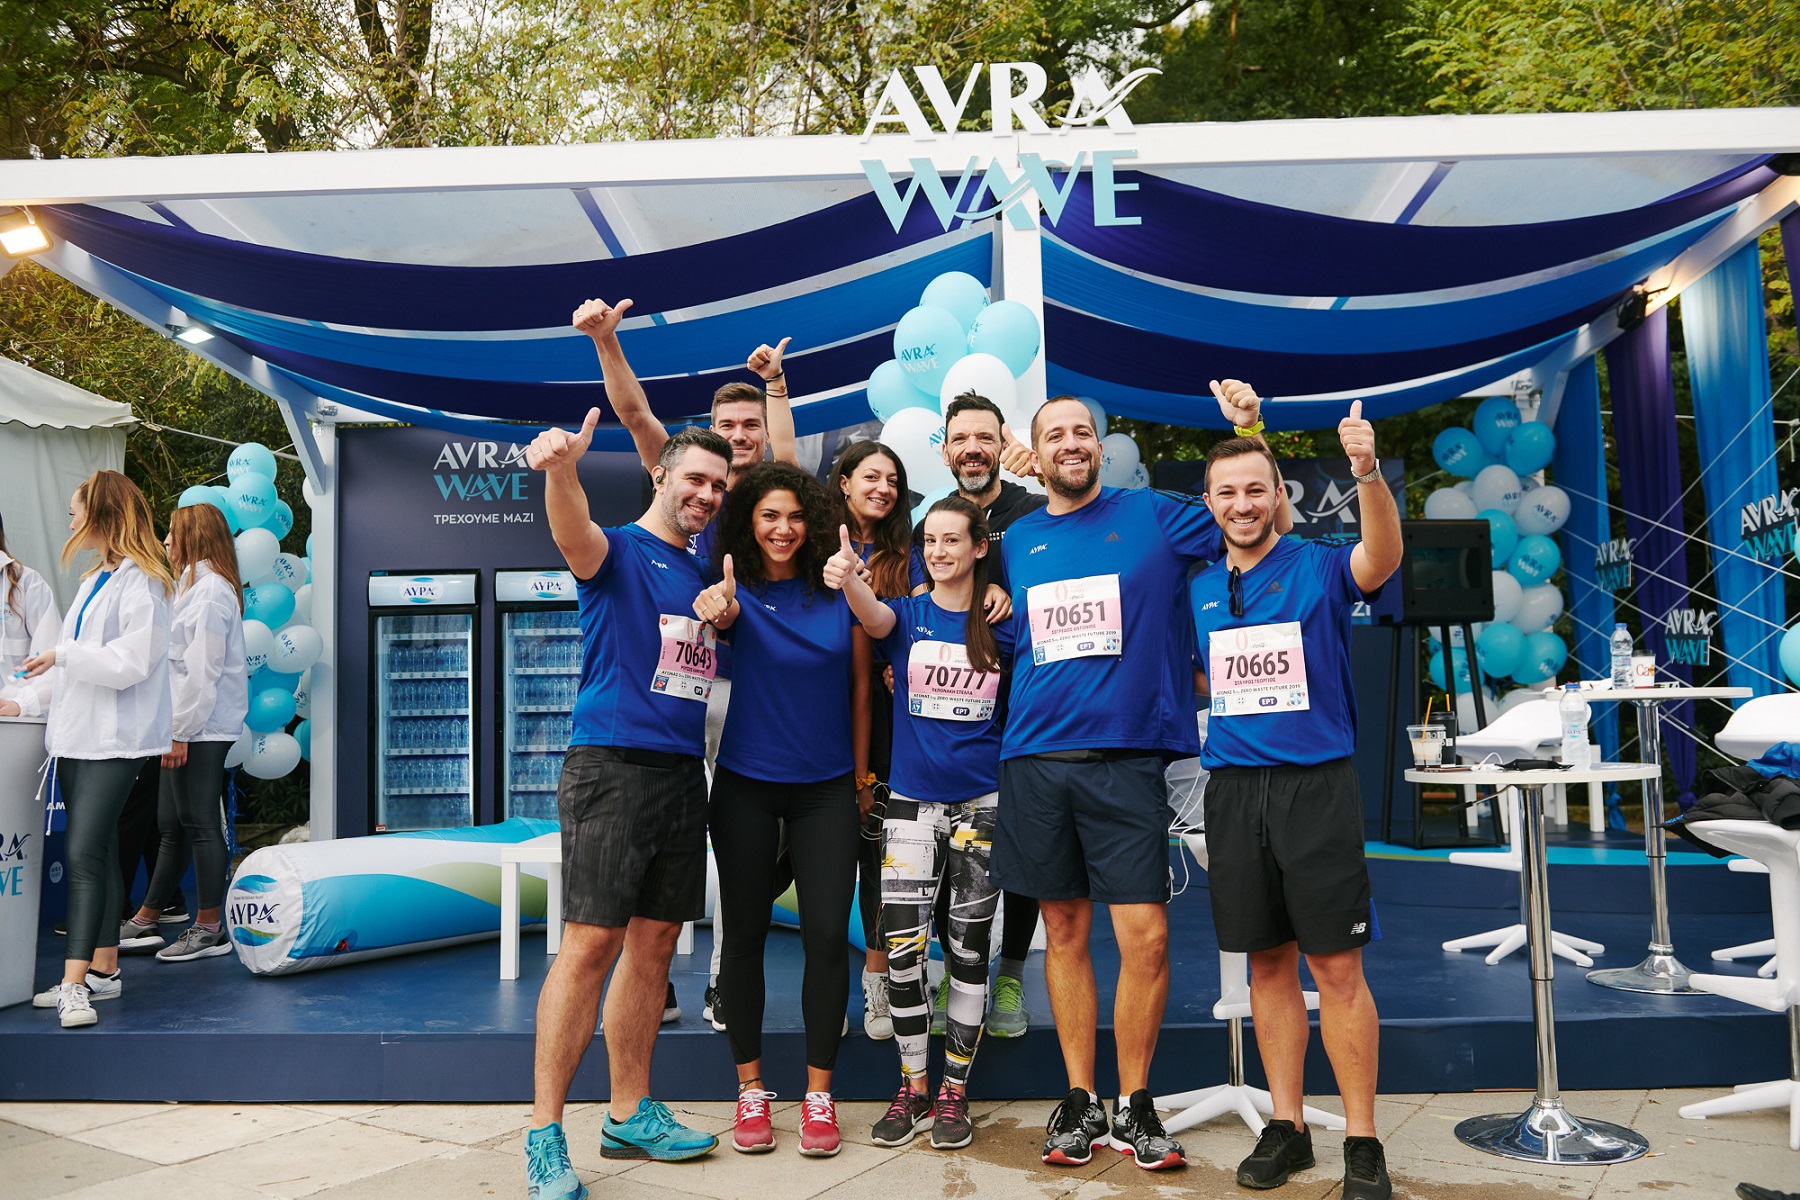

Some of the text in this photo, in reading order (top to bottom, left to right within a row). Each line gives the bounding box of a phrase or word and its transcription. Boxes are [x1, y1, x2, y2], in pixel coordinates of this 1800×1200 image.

[860, 61, 1164, 144] AVRA
[859, 149, 1142, 235] WAVE
[901, 344, 938, 361] AVRA
[904, 358, 940, 374] WAVE
[433, 441, 531, 470] AVRA
[239, 494, 269, 507] AVRA
[433, 473, 529, 501] WAVE
[433, 512, 534, 525] ΤΡΕΧΟΥΜΕ ΜΑΖΙ
[1741, 487, 1800, 536] AVRA
[1595, 538, 1637, 567] AVRA
[1596, 562, 1631, 591] WAVE
[1043, 601, 1106, 630] 70651
[1665, 608, 1717, 637] AVRA
[676, 641, 712, 670] 70643
[1225, 651, 1290, 680] 70665
[1665, 637, 1709, 666] WAVE
[924, 665, 988, 690] 70777
